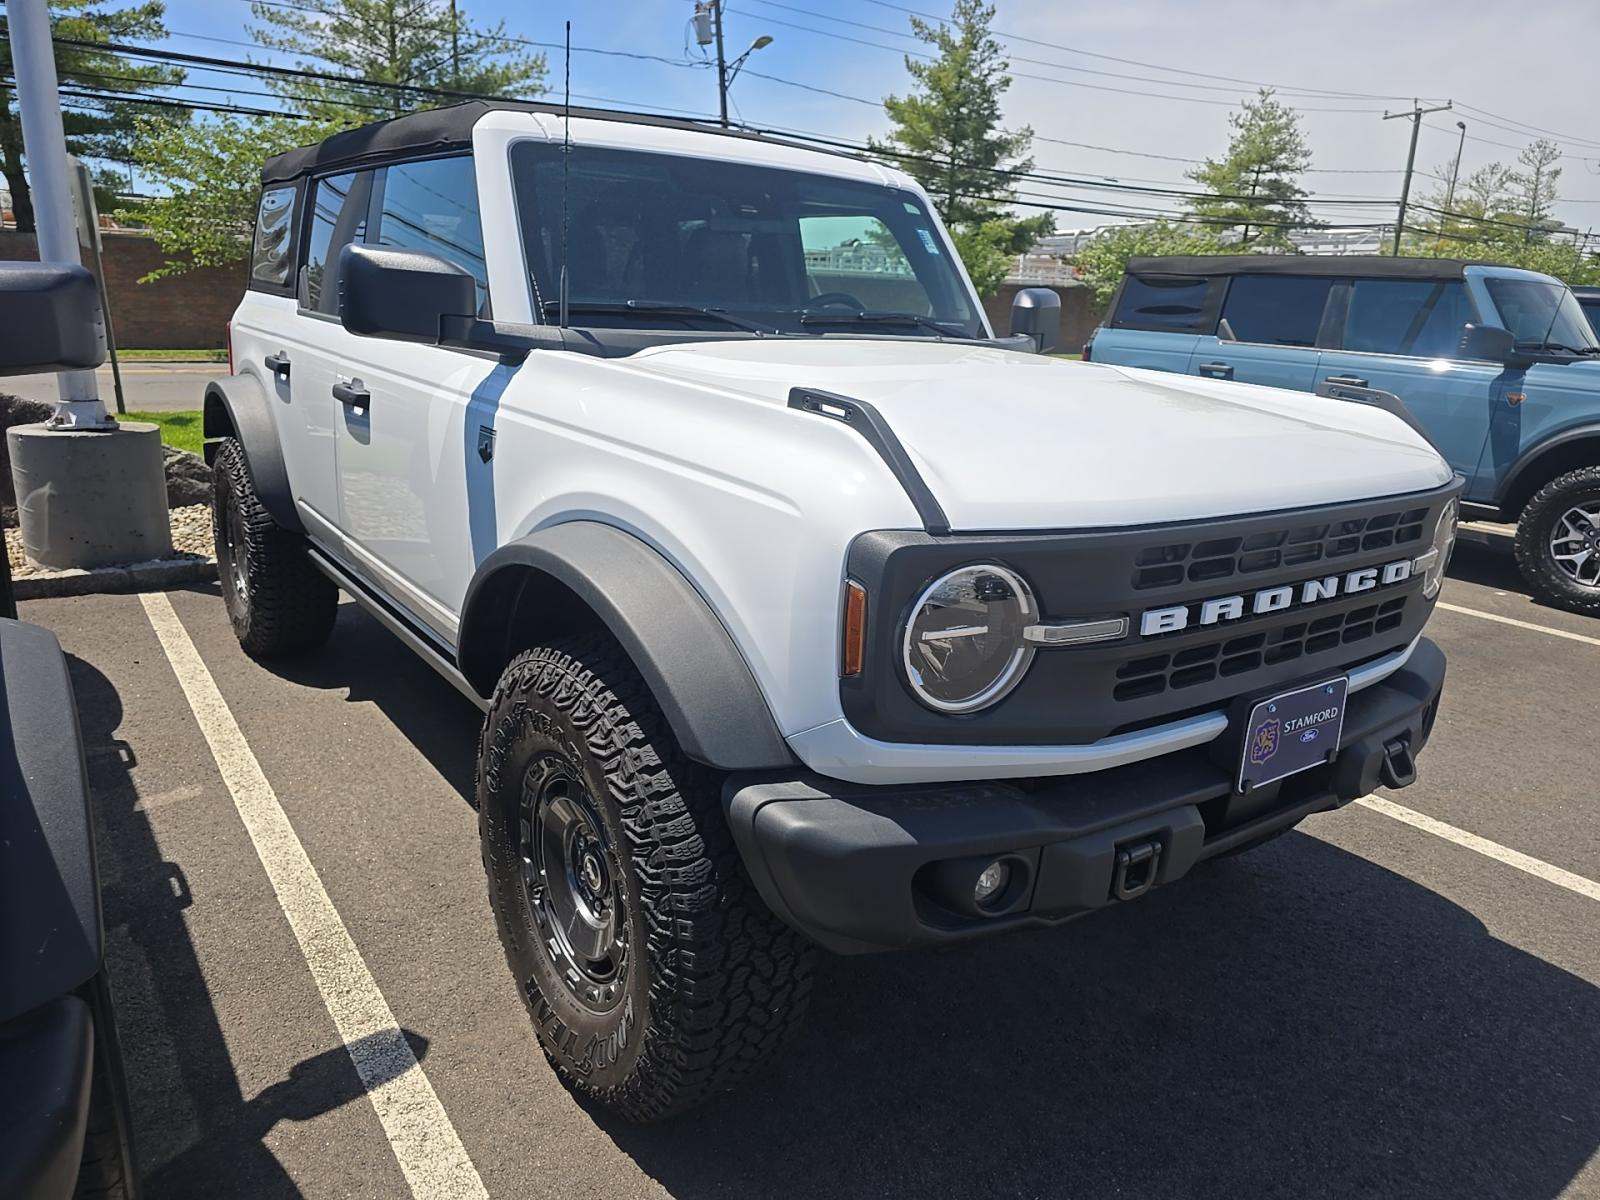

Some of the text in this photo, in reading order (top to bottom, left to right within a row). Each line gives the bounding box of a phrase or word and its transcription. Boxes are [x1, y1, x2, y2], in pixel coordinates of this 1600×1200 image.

[1140, 559, 1412, 636] BRONCO
[1283, 707, 1338, 733] STAMFORD
[1301, 729, 1318, 742] Ford
[525, 974, 634, 1076] GOODYEAR
